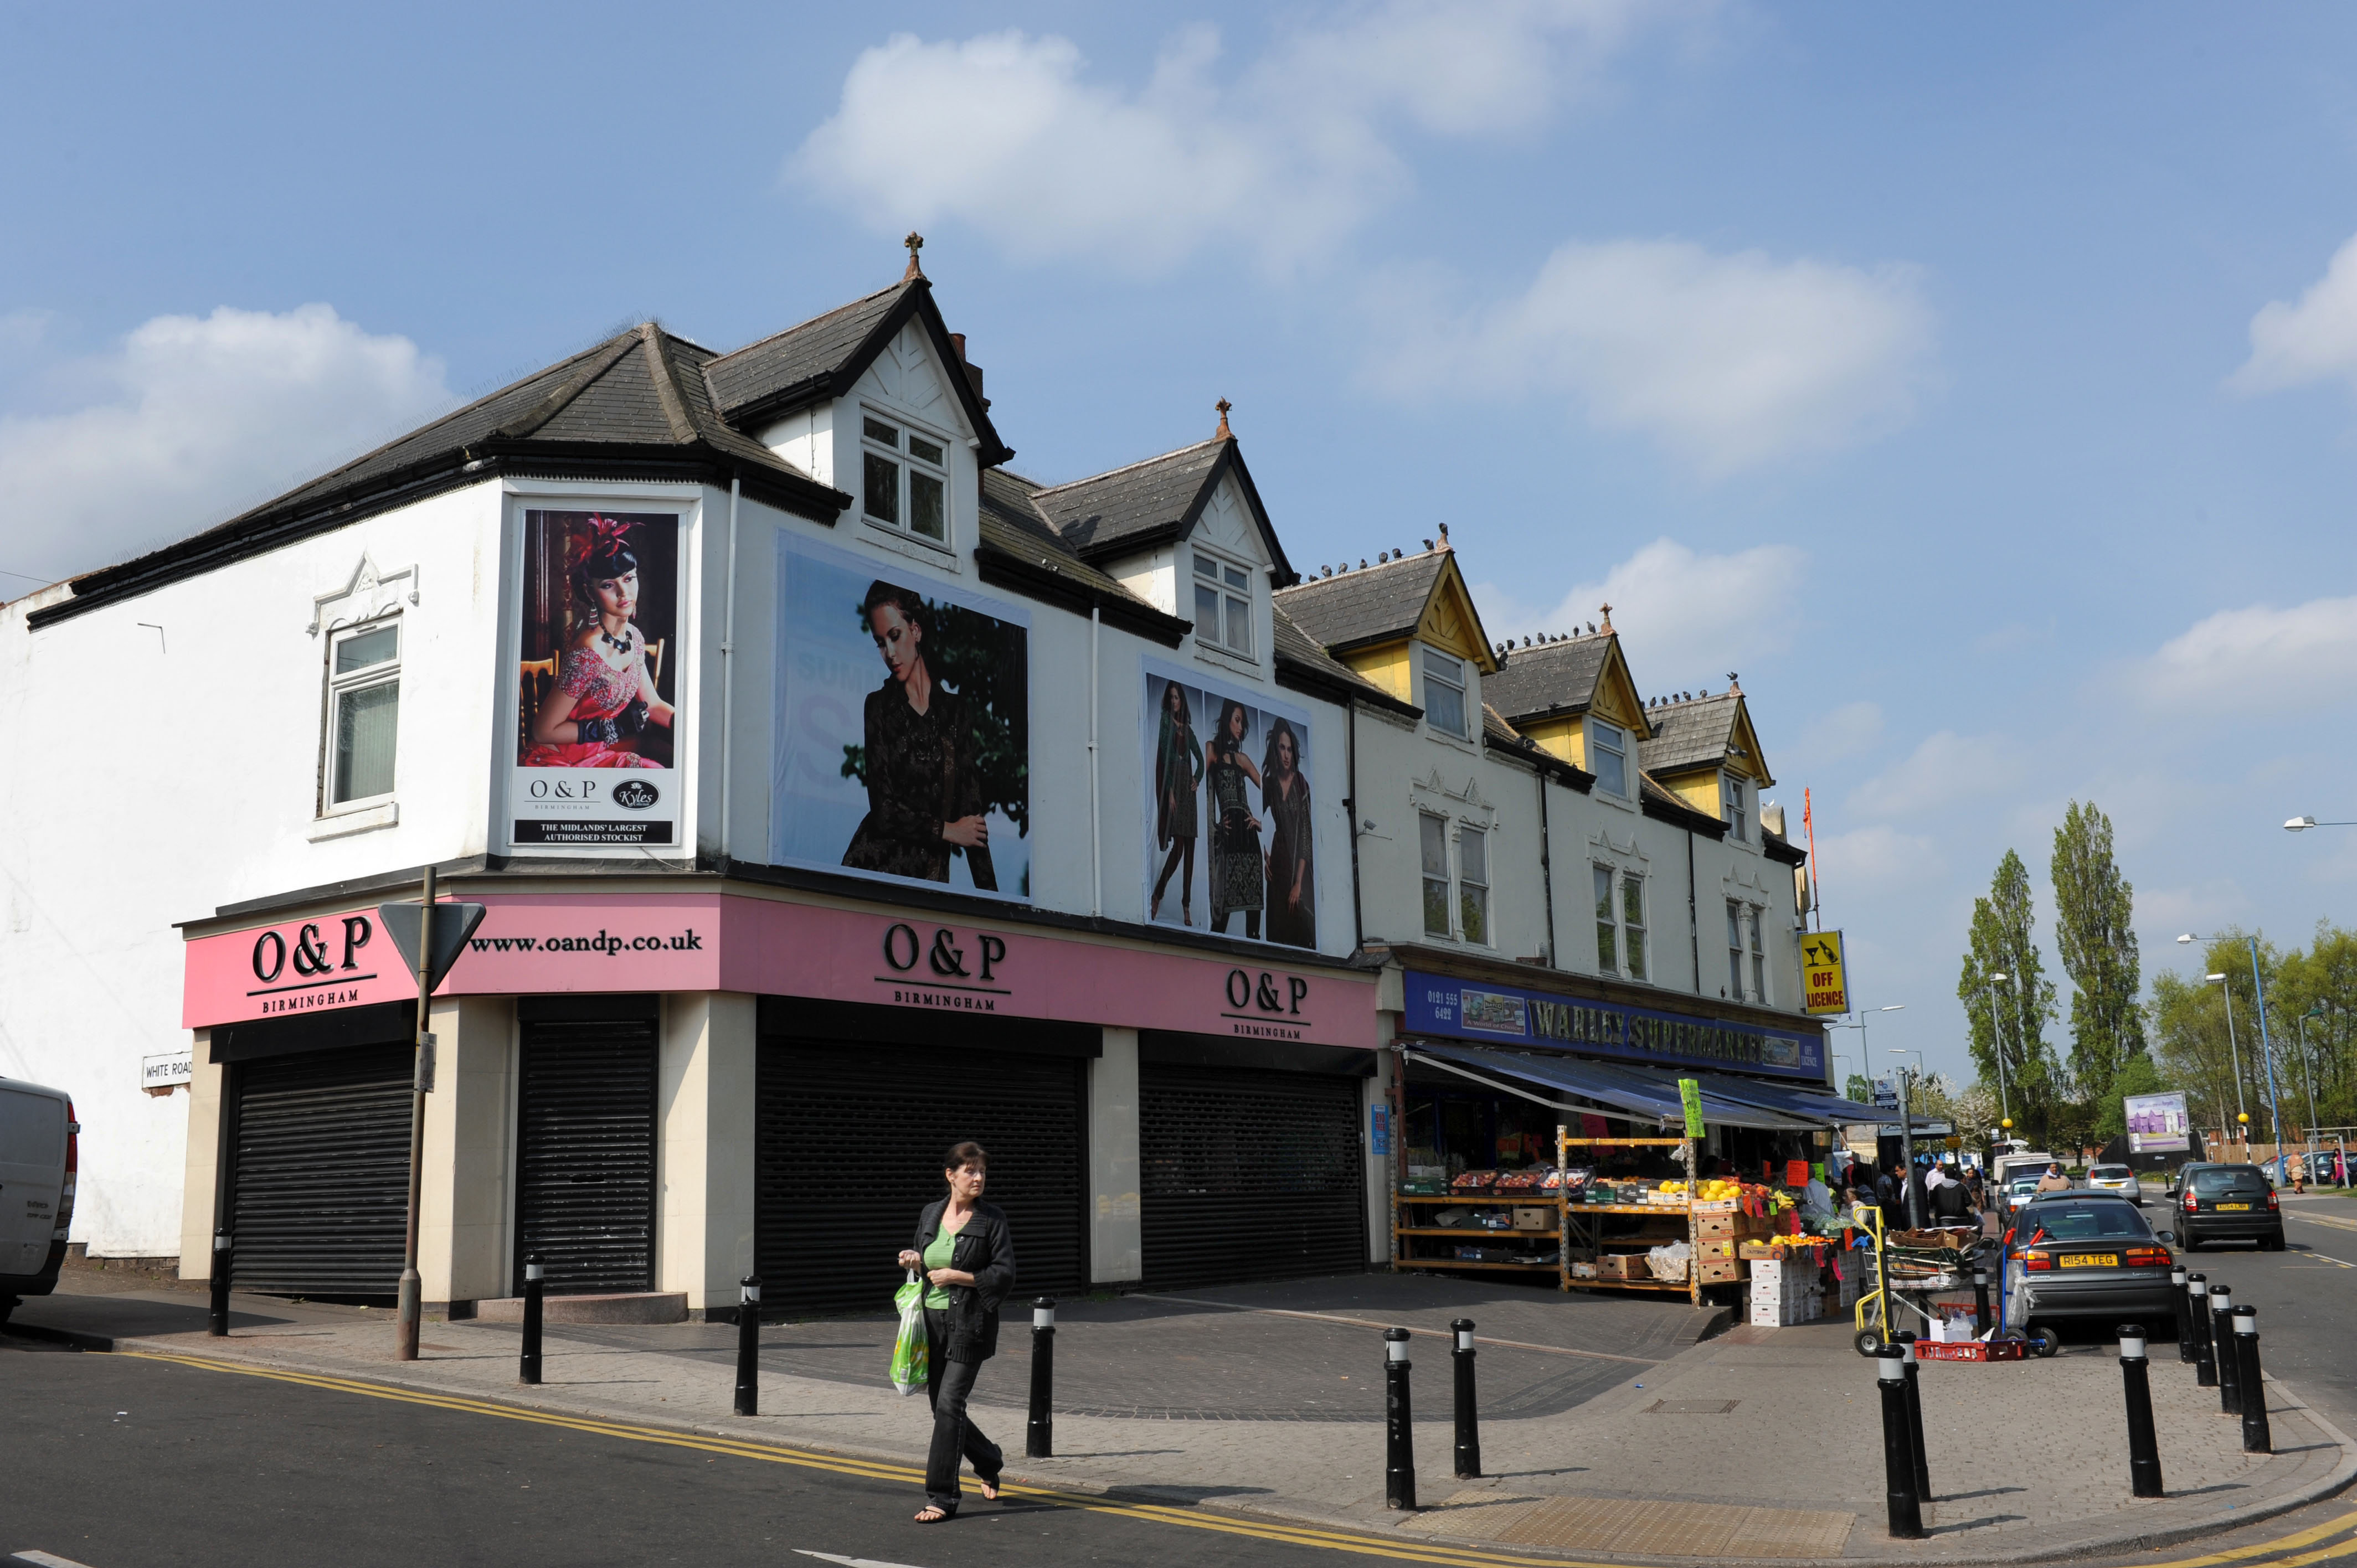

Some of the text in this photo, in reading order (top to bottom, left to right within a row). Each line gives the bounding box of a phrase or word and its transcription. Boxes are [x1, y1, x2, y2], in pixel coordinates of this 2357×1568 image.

[619, 790, 652, 806] Kyles
[470, 929, 703, 956] www.oandp.co.uk
[1813, 972, 1833, 987] OFF
[263, 989, 358, 1013] BIRMINGHAM
[894, 991, 995, 1010] BIRMINGHAM
[1428, 991, 1458, 1005] 0121 555
[1807, 991, 1844, 1007] LICENCE
[1435, 1007, 1452, 1020] 6422
[1234, 1024, 1300, 1039] BIRMINGHAM
[1527, 999, 1765, 1064] WARLEY SUPERMARKET
[1804, 1045, 1813, 1055] OFF
[1802, 1055, 1816, 1067] LICENCE
[146, 1061, 192, 1078] WHITE ROAD
[2063, 1255, 2113, 1265] R154 TEG
